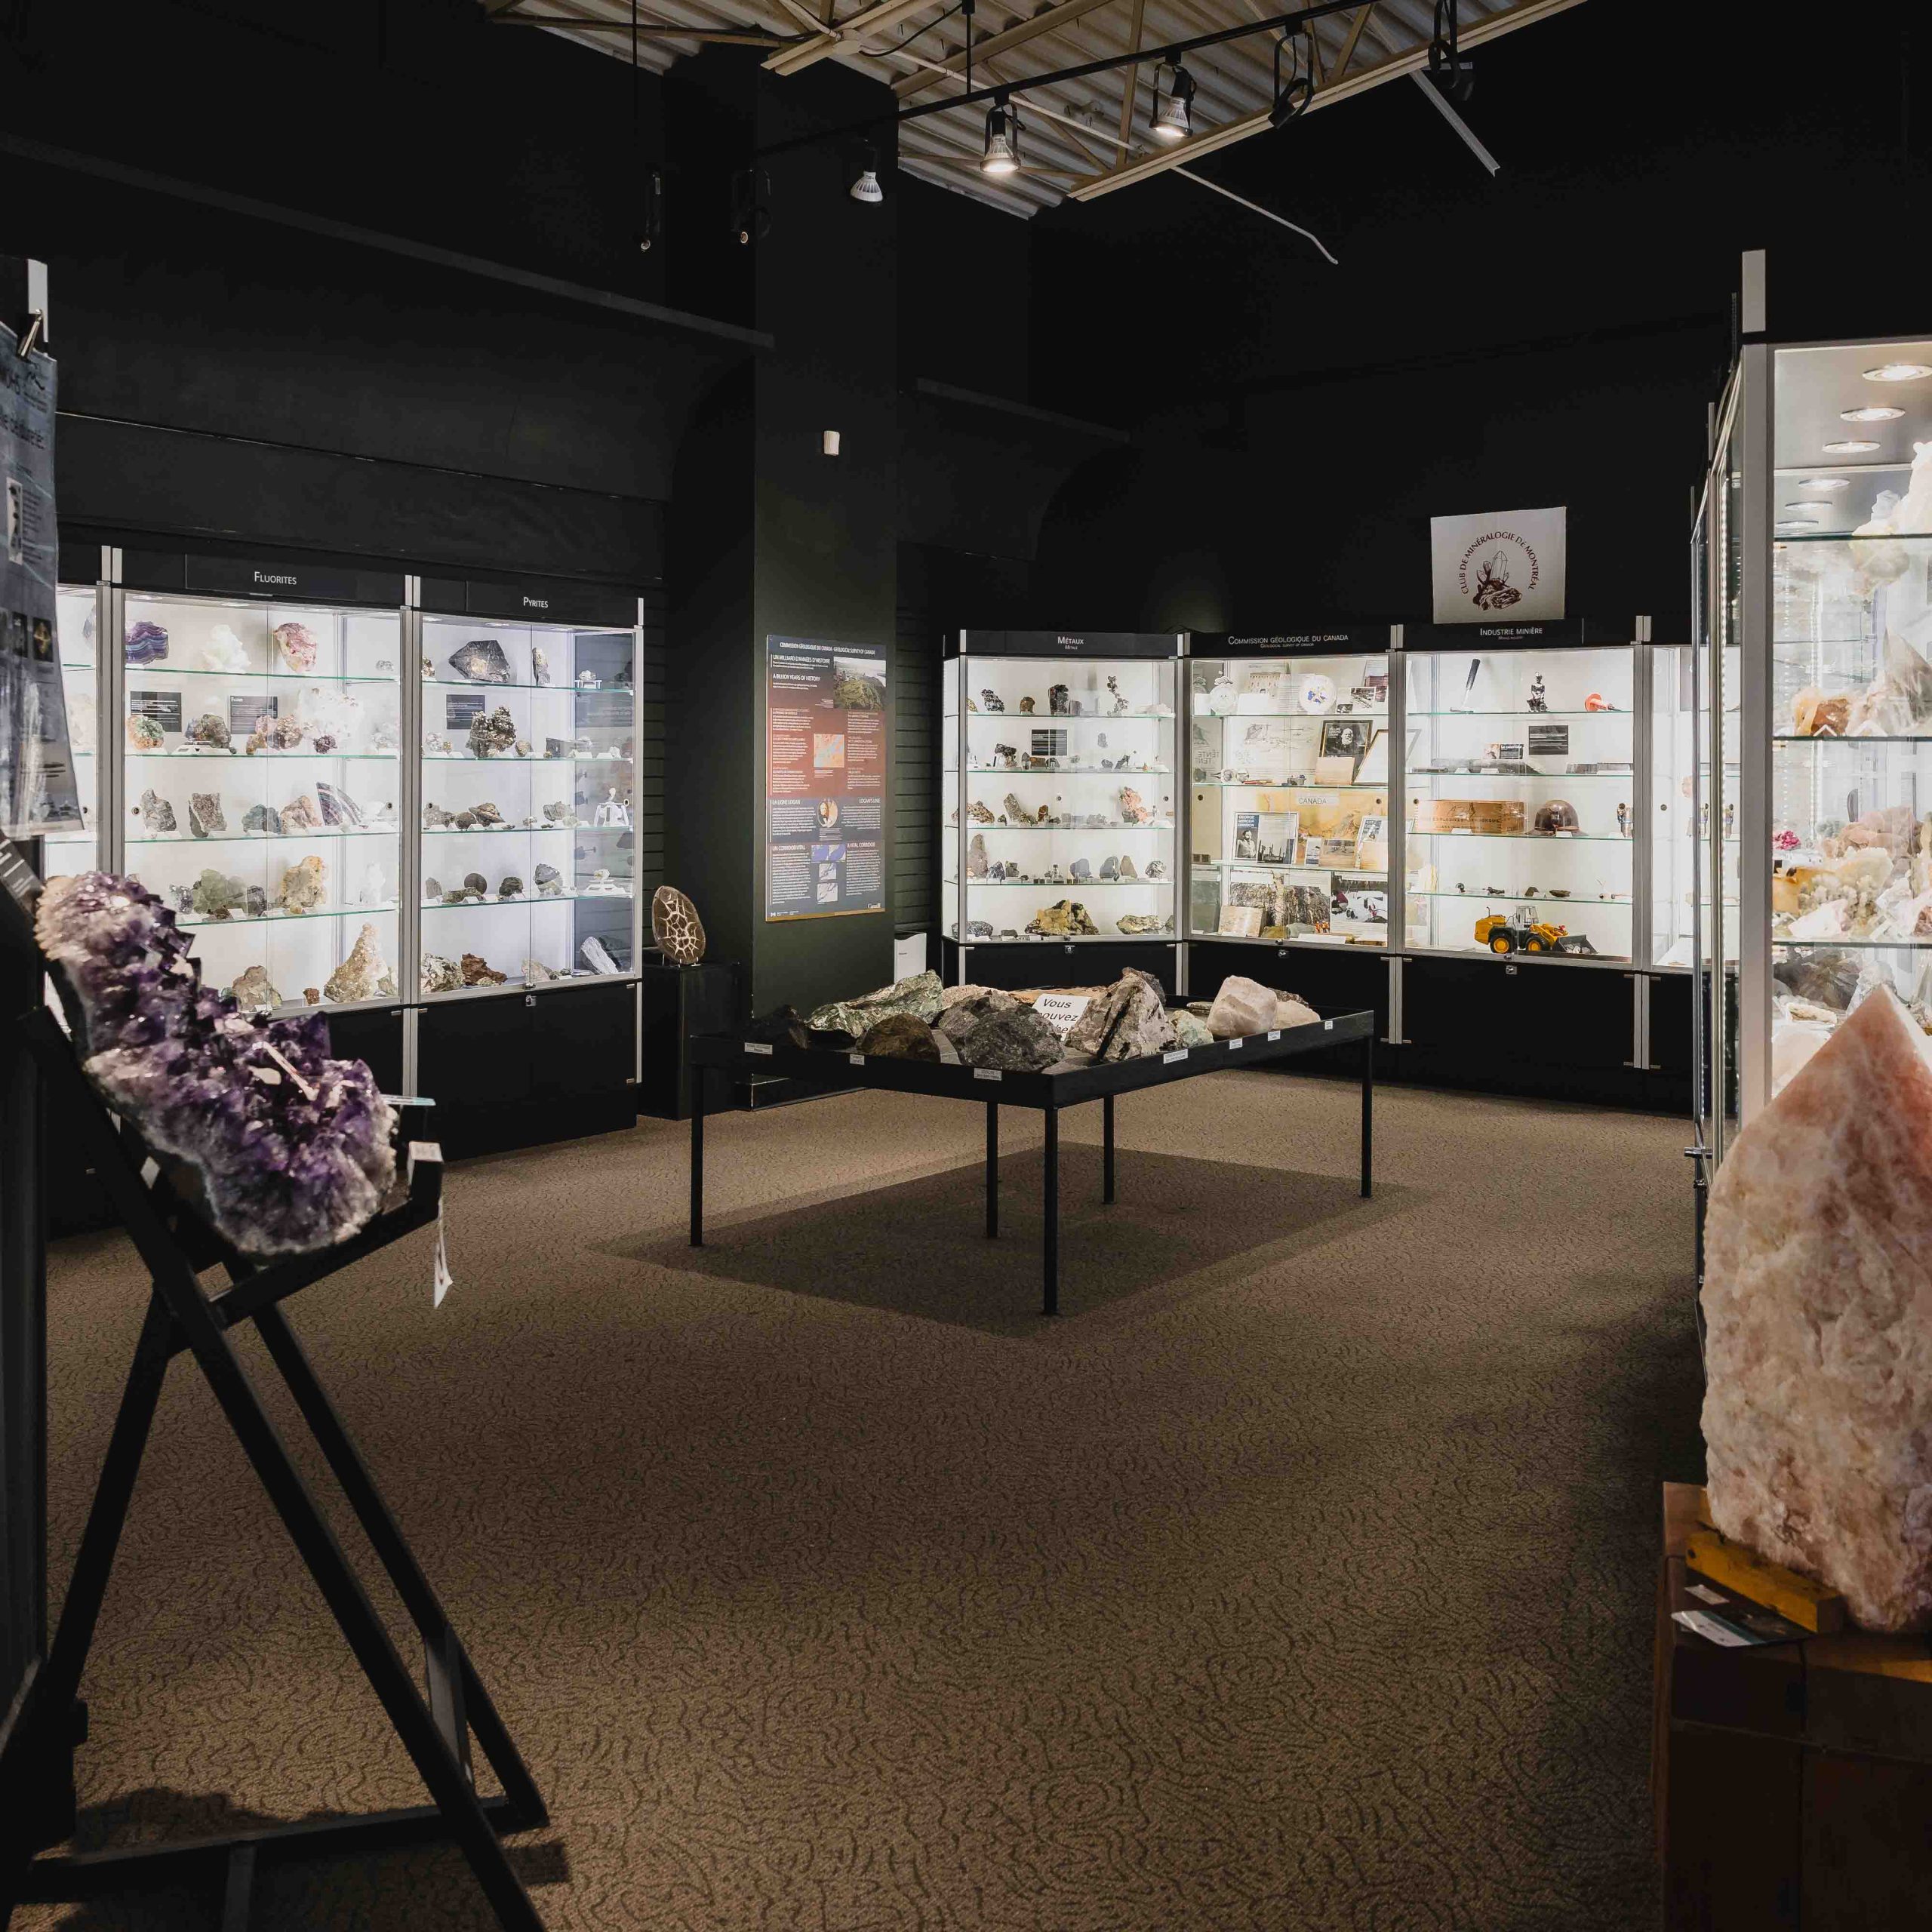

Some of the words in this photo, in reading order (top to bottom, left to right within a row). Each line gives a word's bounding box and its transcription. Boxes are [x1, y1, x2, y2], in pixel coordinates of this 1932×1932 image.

[1464, 531, 1515, 558] MINÉRALOGIE
[1515, 536, 1526, 547] DE
[1460, 558, 1468, 571] DE
[1524, 545, 1540, 591] MONTRÉAL
[254, 571, 297, 585] FLUORITES
[1459, 573, 1469, 595] CLUB
[523, 596, 549, 608] PYRITES
[1516, 626, 1543, 635] MINIÈRE
[1057, 635, 1084, 645] MÉTAUX
[1228, 635, 1269, 645] COMMISSION
[1270, 635, 1309, 643] GÉOLOGIQUE
[1043, 998, 1072, 1008] Vous
